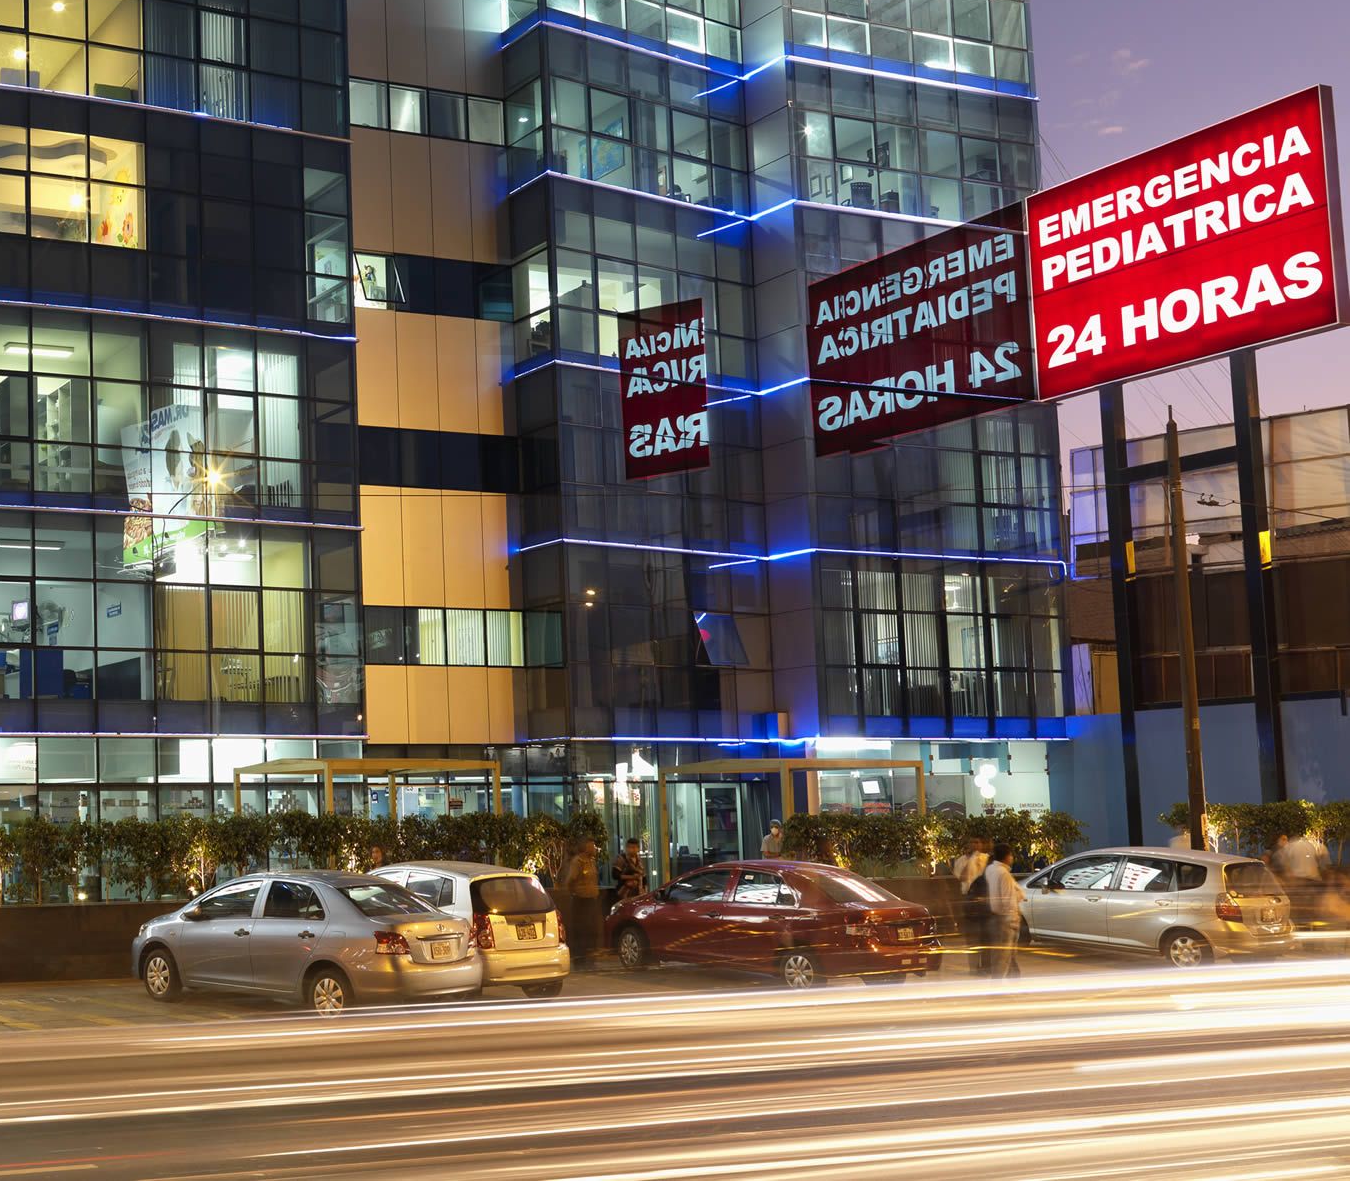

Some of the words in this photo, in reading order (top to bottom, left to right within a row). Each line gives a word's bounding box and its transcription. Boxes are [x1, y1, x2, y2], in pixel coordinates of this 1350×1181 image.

[1039, 125, 1311, 247] EMERGENCIA
[1042, 172, 1315, 291] PEDIATRICA
[1047, 321, 1107, 369] 24
[1121, 250, 1324, 347] HORAS
